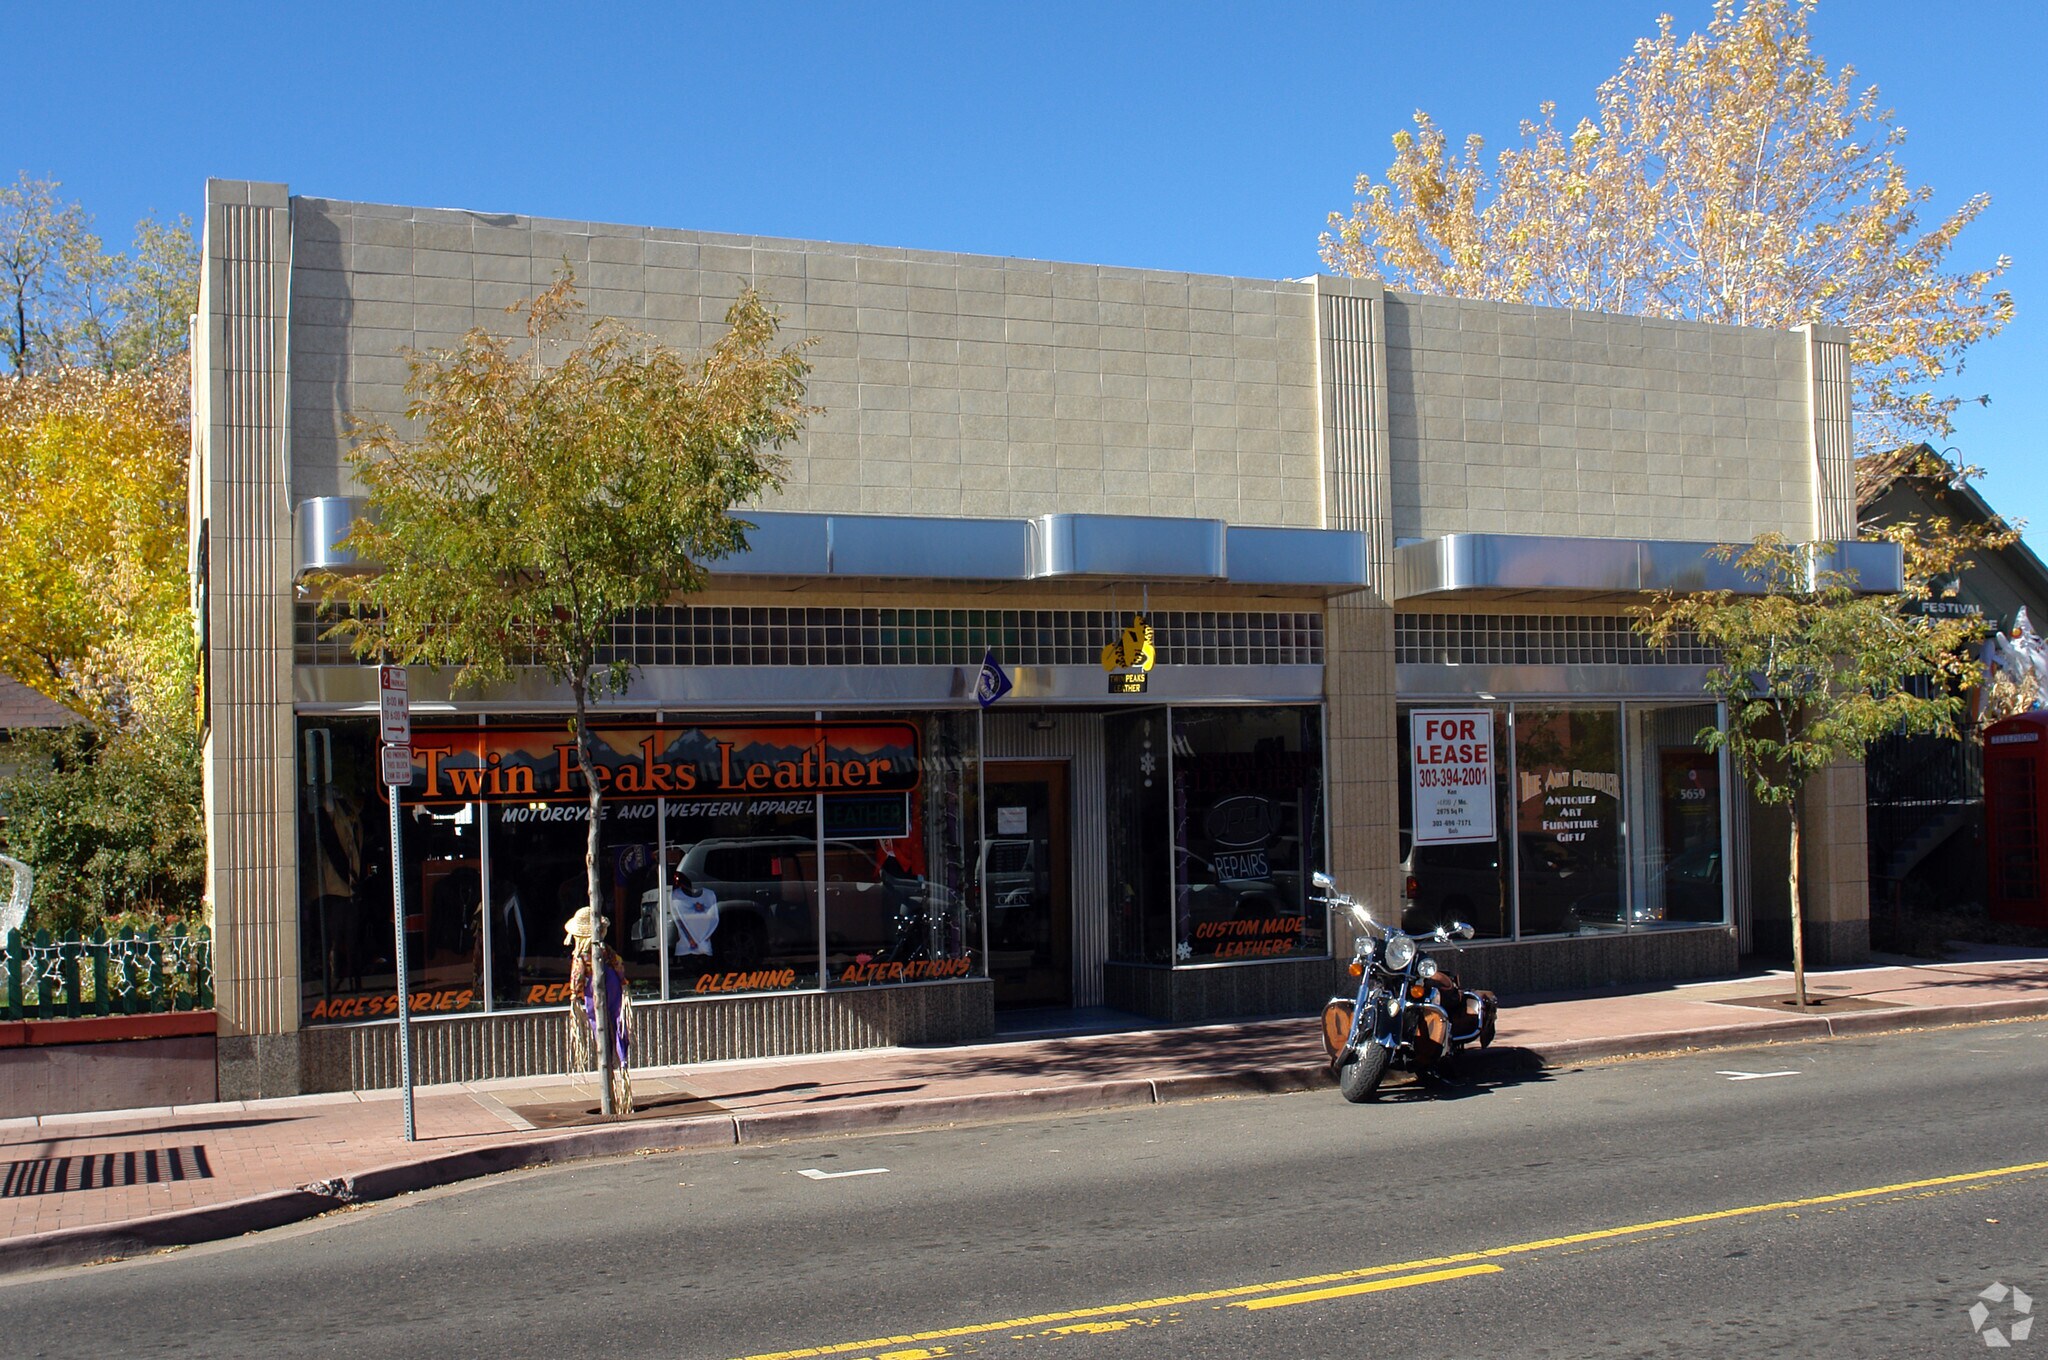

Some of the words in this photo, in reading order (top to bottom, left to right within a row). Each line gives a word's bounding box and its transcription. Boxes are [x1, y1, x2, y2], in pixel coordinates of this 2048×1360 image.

[1922, 602, 1983, 615] FESTIVAL
[1114, 684, 1141, 692] LEATHER
[1125, 674, 1145, 683] PEAKS
[1426, 720, 1476, 741] FOR
[1416, 744, 1488, 764] LEASE
[412, 746, 537, 797] Twin
[554, 736, 697, 793] Peaks
[716, 736, 893, 791] Leather
[1420, 767, 1487, 788] 303-394-2001
[1520, 771, 1542, 802] THE
[1545, 769, 1570, 792] ART
[1572, 769, 1621, 800] PEDDLER
[1545, 795, 1597, 806] ANTIQUES
[1680, 788, 1706, 800] 5659
[617, 804, 656, 819] AND
[665, 802, 743, 818] WESTERN
[747, 800, 815, 816] APPAREL
[1560, 807, 1582, 817] ART
[1542, 820, 1600, 831] FURNITURE
[1557, 833, 1586, 842] GIFTS
[1215, 852, 1269, 880] REPAIRS
[997, 895, 1028, 905] OPEN
[1196, 917, 1260, 939] CUSTOM
[1262, 915, 1306, 935] MADE
[1214, 938, 1293, 958] LEATHERS
[841, 956, 972, 984] ALTERATIONS
[695, 968, 796, 994] CLEANING
